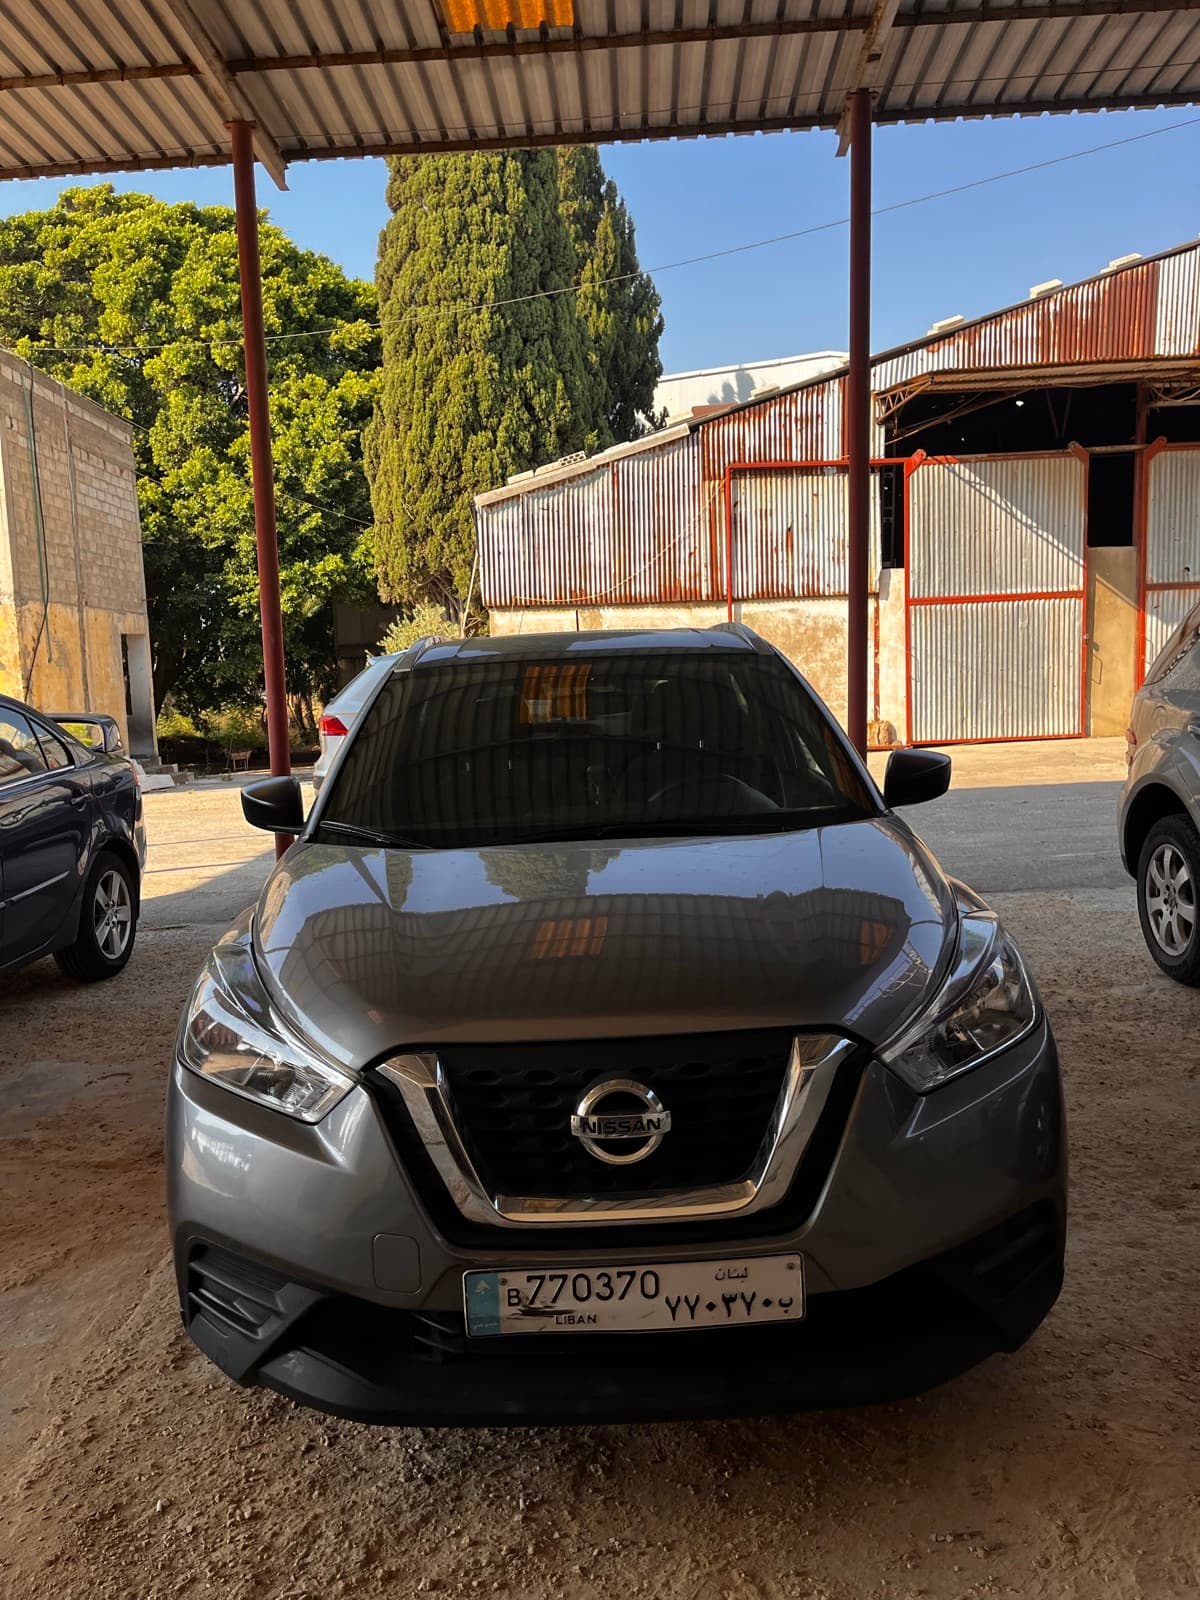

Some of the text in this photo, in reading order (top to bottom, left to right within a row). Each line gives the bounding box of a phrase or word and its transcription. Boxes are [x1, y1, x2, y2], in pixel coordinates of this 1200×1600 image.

[582, 1118, 662, 1134] NISSAN
[714, 1267, 749, 1282] لبنان
[555, 1314, 598, 1325] LIBAN
